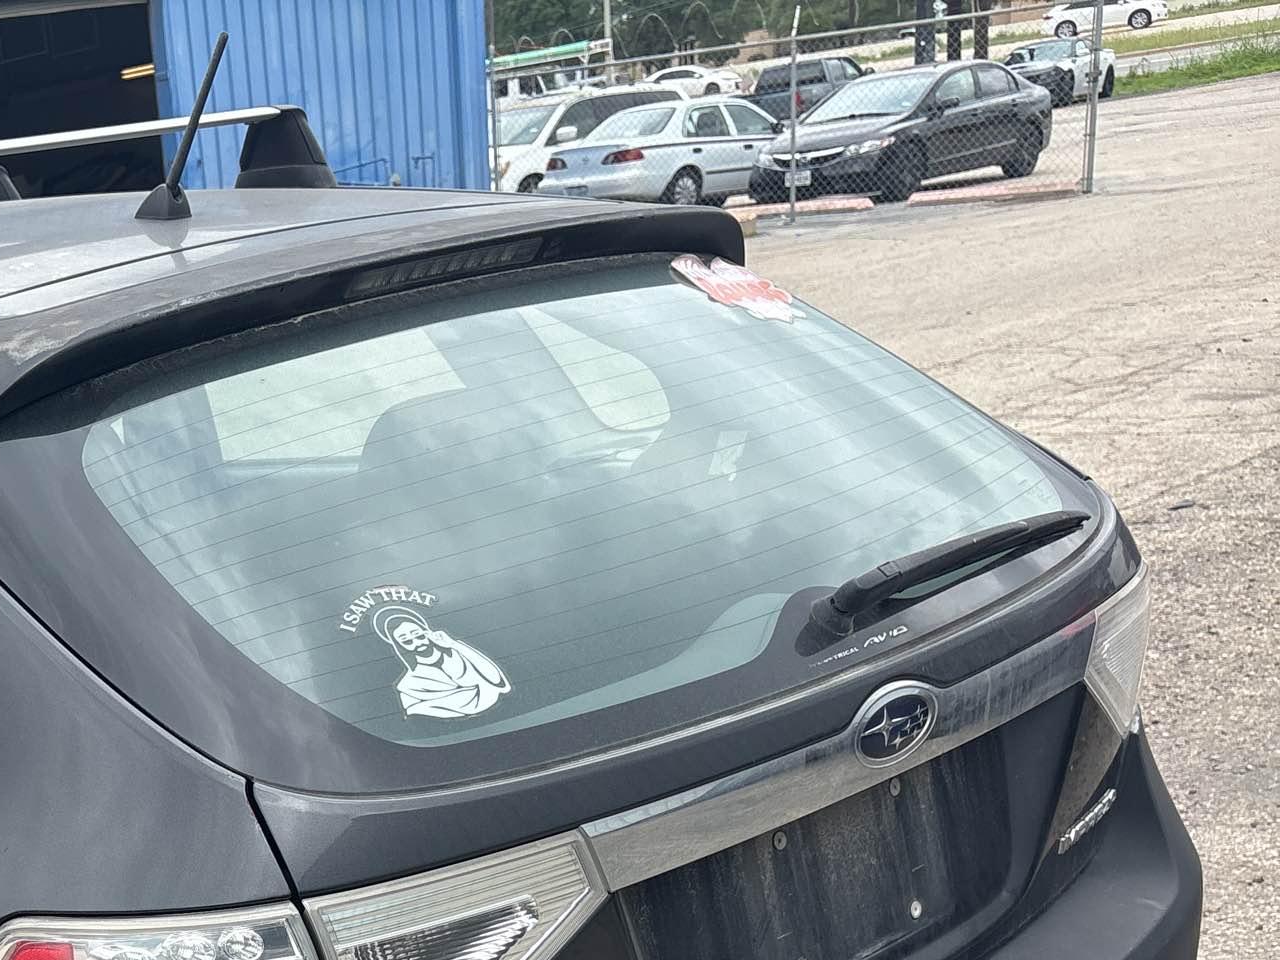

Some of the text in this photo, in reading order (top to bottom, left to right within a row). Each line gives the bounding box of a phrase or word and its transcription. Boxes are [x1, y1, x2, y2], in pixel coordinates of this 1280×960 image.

[339, 587, 436, 632] I SAW THAT
